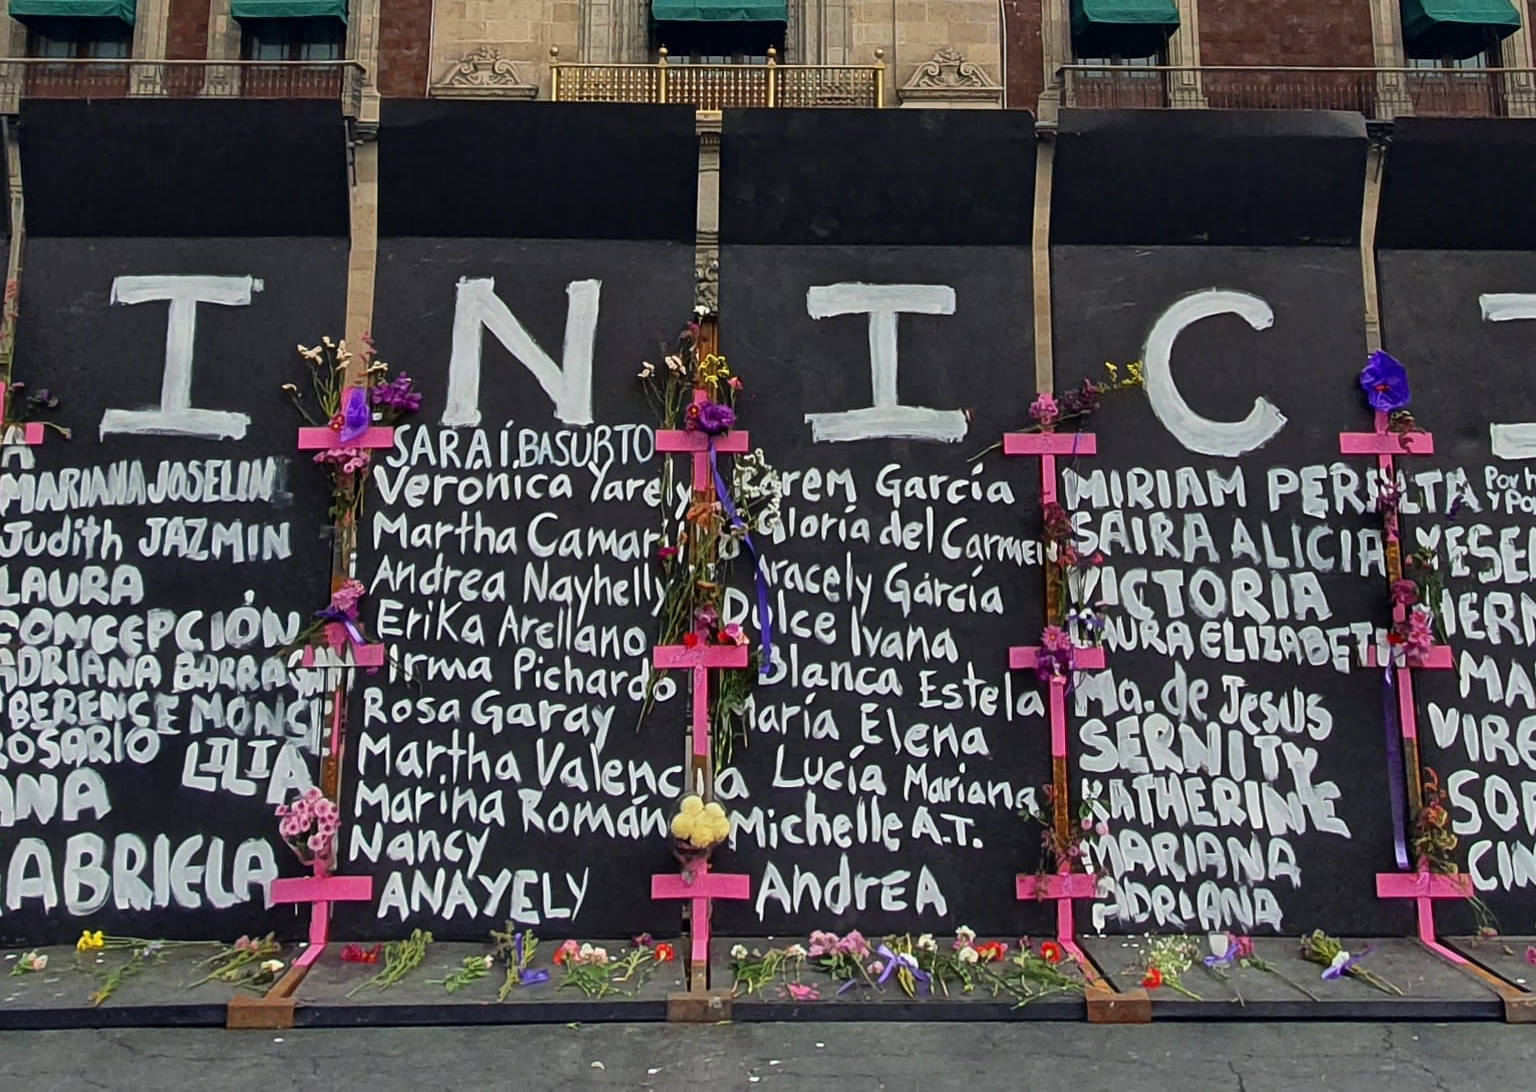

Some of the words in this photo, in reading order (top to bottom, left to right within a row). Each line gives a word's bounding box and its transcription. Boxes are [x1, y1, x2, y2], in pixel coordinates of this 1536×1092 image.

[373, 459, 573, 508] Verónica
[875, 462, 1016, 508] García
[1062, 465, 1247, 510] MIRIAM
[138, 516, 292, 564] JAZMIN
[374, 511, 520, 554] Martha
[879, 506, 934, 554] del
[1069, 510, 1220, 563] SAIRA
[1230, 519, 1387, 577] ALICIA
[370, 554, 506, 603] Andrea
[1066, 567, 1333, 624] VICTORIA
[498, 605, 647, 658] Arellano
[723, 587, 837, 645] Dulce
[849, 605, 959, 665] Ivana
[389, 644, 493, 683] Irma
[513, 647, 677, 702] Pichardo
[759, 643, 904, 697] Blanca
[919, 661, 1046, 721] Estela
[1161, 661, 1209, 723] de
[363, 688, 461, 729] Rosa
[470, 690, 616, 754] Garay
[860, 705, 990, 758] Elena
[358, 730, 521, 784] Martha
[535, 737, 750, 800] Valencia
[772, 743, 886, 795] Lucía
[903, 763, 1042, 818] Mariana
[355, 776, 505, 829] Marina
[521, 792, 668, 841] Román
[728, 789, 902, 851] Michelle
[349, 823, 489, 881] Nancy
[1079, 828, 1302, 890] MARIANA
[376, 866, 590, 925] ANAYELY
